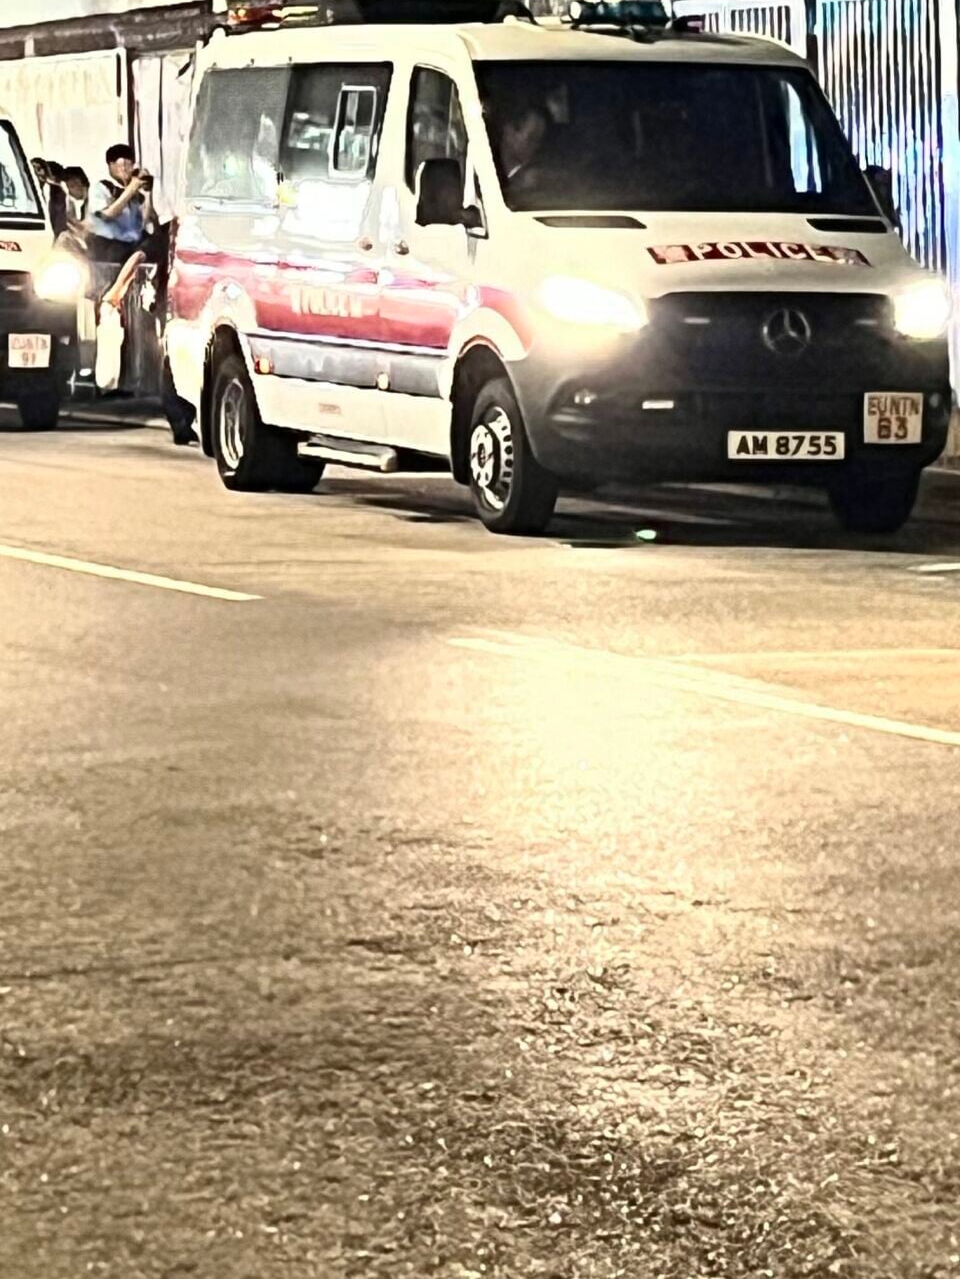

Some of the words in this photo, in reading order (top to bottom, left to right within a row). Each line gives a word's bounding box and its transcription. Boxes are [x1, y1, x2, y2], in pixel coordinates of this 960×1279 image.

[688, 241, 834, 264] POLICE
[736, 436, 768, 455] AM
[775, 435, 837, 456] 8755
